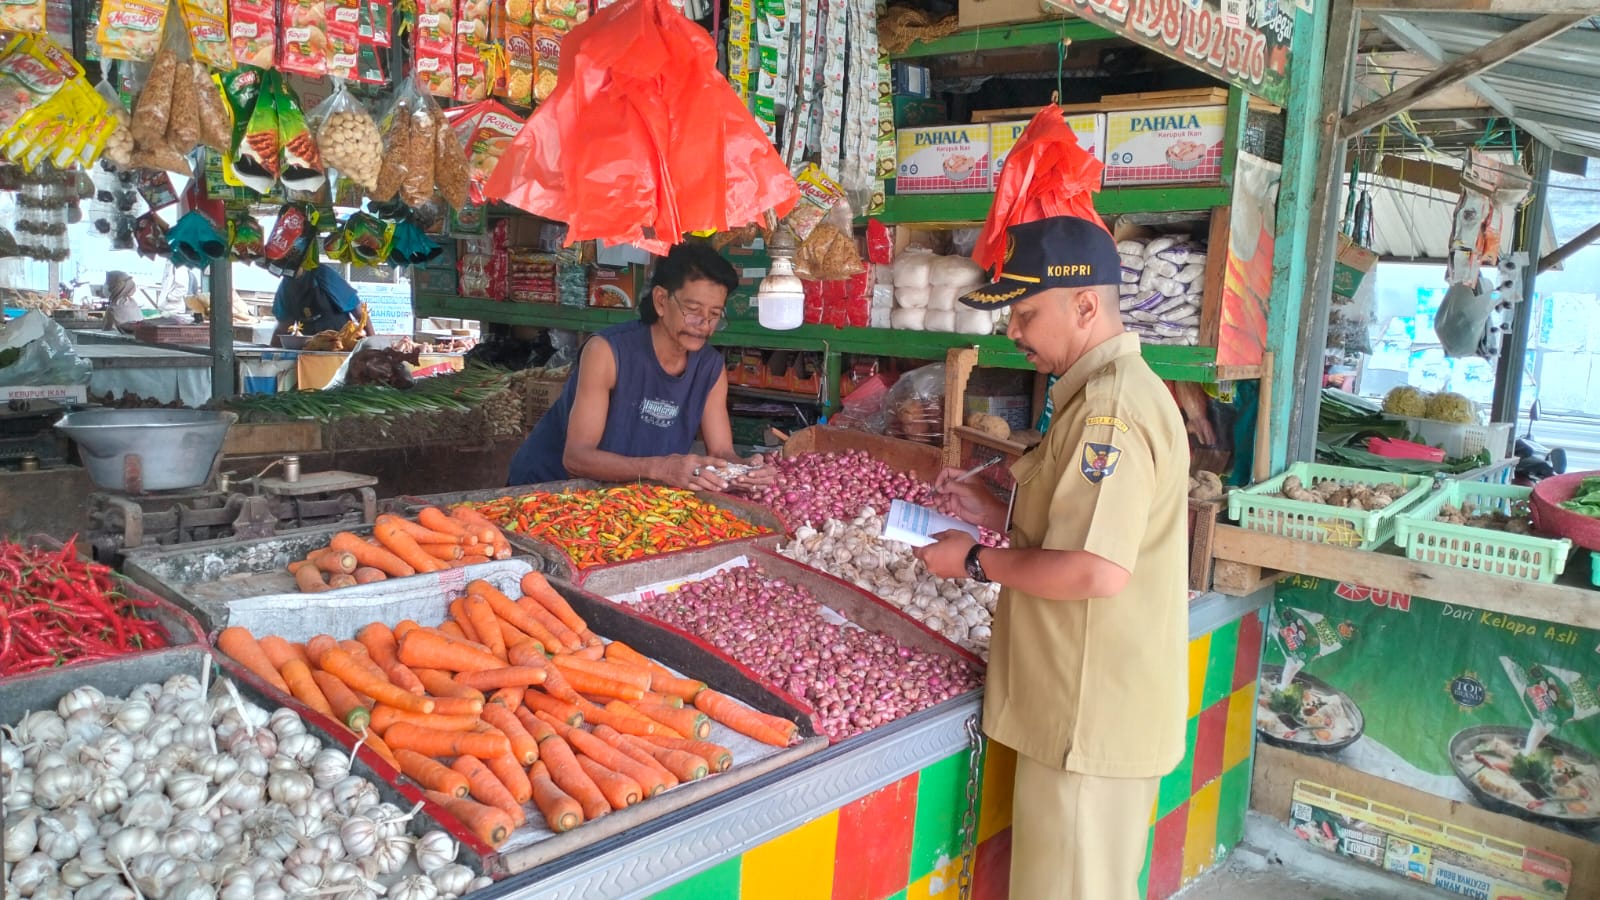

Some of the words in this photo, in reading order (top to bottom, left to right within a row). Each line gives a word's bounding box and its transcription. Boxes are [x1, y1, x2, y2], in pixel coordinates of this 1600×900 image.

[107, 10, 158, 26] Masako
[485, 115, 518, 132] Royco
[1130, 114, 1202, 132] PAHALA
[914, 130, 969, 145] PAHALA
[1047, 265, 1091, 277] KORPRI
[1442, 604, 1475, 621] Dari
[1480, 611, 1537, 636] Kelapa
[1544, 627, 1579, 645] Asli
[1455, 681, 1483, 695] TOP
